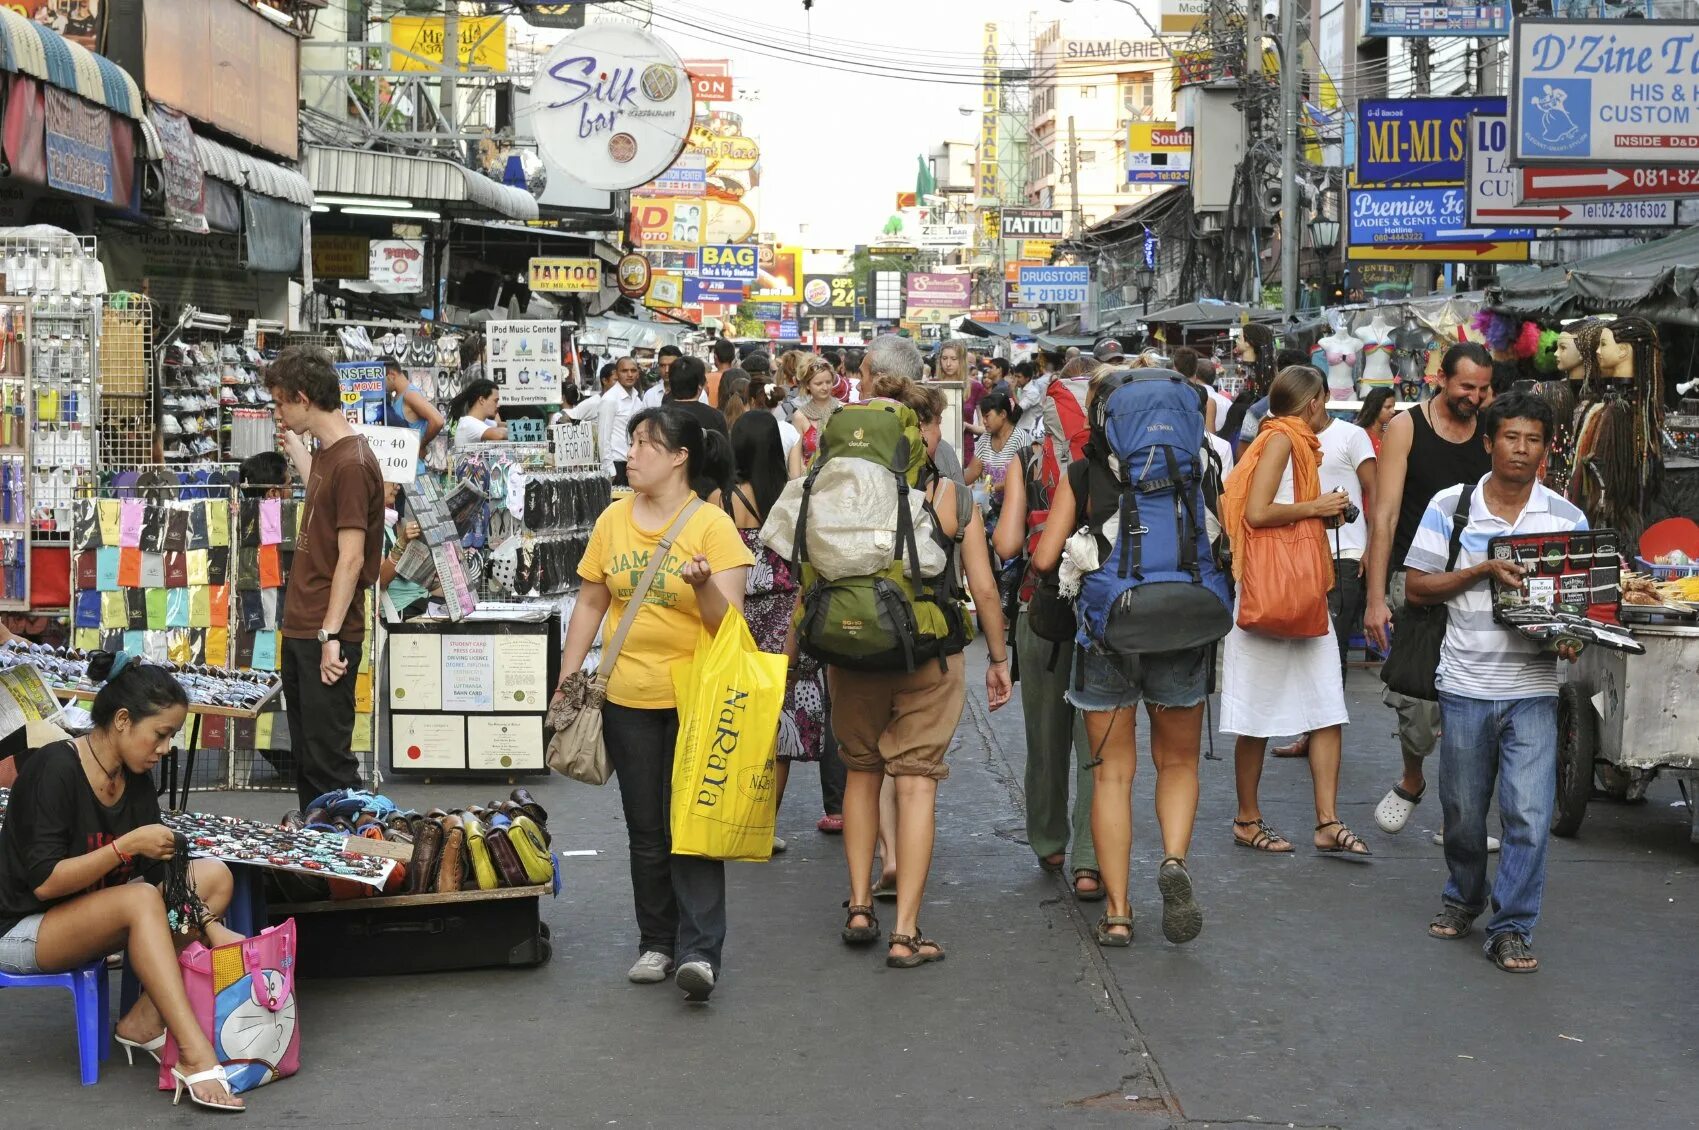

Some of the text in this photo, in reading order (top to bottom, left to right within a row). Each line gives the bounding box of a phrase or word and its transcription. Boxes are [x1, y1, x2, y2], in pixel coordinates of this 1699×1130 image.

[1068, 41, 1110, 58] SIAM
[1532, 33, 1653, 75] D'Zine
[547, 57, 639, 108] Silk
[693, 81, 725, 93] ON
[1631, 84, 1686, 102] HIS &
[579, 102, 616, 138] bar
[982, 70, 998, 161] ORINTAL
[1600, 106, 1690, 123] CUSTOM
[1367, 119, 1466, 163] MI-MI S
[1478, 121, 1508, 152] LO
[1617, 136, 1697, 147] INSIDE D&D
[1486, 157, 1511, 173] LA
[982, 164, 997, 196] INN
[1353, 193, 1435, 218] Premier
[1003, 217, 1063, 234] TATTOO
[1354, 215, 1465, 228] LADIES & GENTS CUS
[1384, 227, 1413, 235] Hotline
[702, 247, 755, 266] BAG
[533, 265, 597, 280] TATTOO
[1022, 271, 1088, 283] DRUGSTORE
[1040, 288, 1086, 302] ขายยา
[491, 325, 557, 334] iPod Music Center
[353, 382, 382, 391] MOVIE
[344, 393, 357, 401] TO
[523, 422, 531, 432] 40
[562, 424, 579, 440] FOR
[580, 423, 589, 438] 40
[390, 438, 406, 449] 40
[565, 442, 580, 460] FOR
[581, 441, 591, 458] 100
[848, 440, 871, 448] deuter
[386, 457, 408, 469] 100
[611, 550, 687, 577] JAMICA
[697, 685, 749, 807] NaRaYa
